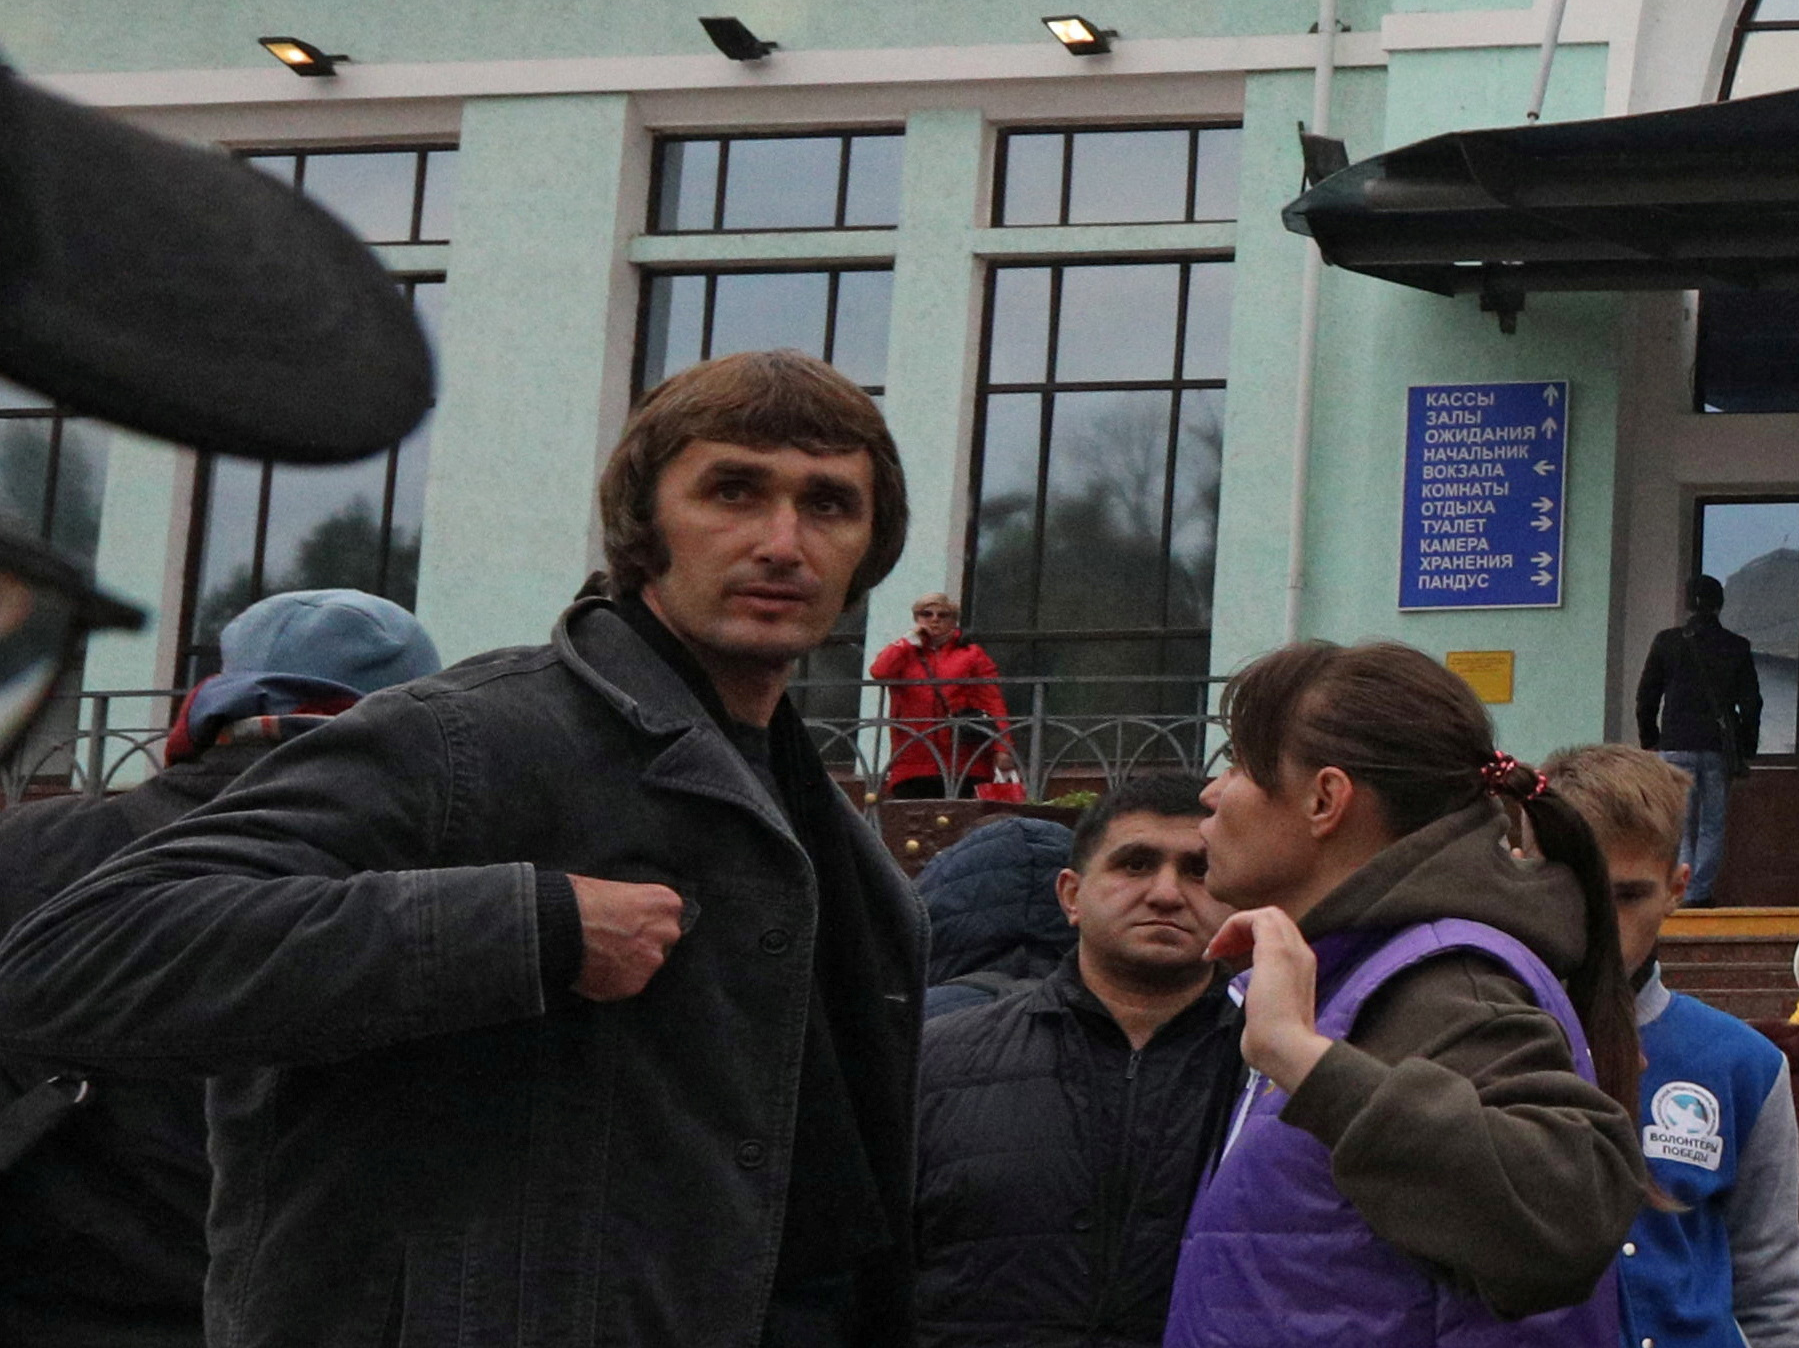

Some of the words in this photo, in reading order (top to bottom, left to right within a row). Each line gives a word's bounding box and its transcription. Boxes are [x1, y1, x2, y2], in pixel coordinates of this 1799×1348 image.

[1426, 392, 1494, 407] КАССЫ
[1426, 410, 1481, 425] ЗАЛЫ
[1425, 426, 1536, 444] ОЖИДАНИЯ
[1423, 446, 1529, 462] НАЧАЛЬНИК
[1423, 464, 1505, 480] ВОКЗАЛА
[1421, 482, 1509, 498] КОМНАТЫ
[1421, 501, 1496, 517] ОТДЫХА
[1422, 518, 1486, 534] ТУАЛЕТ
[1420, 537, 1489, 553] КАМЕРА
[1420, 554, 1513, 571] ХРАНЕНИЯ
[1418, 573, 1489, 591] ПАНДУС
[1663, 1145, 1708, 1162] ПОБЕДЫ
